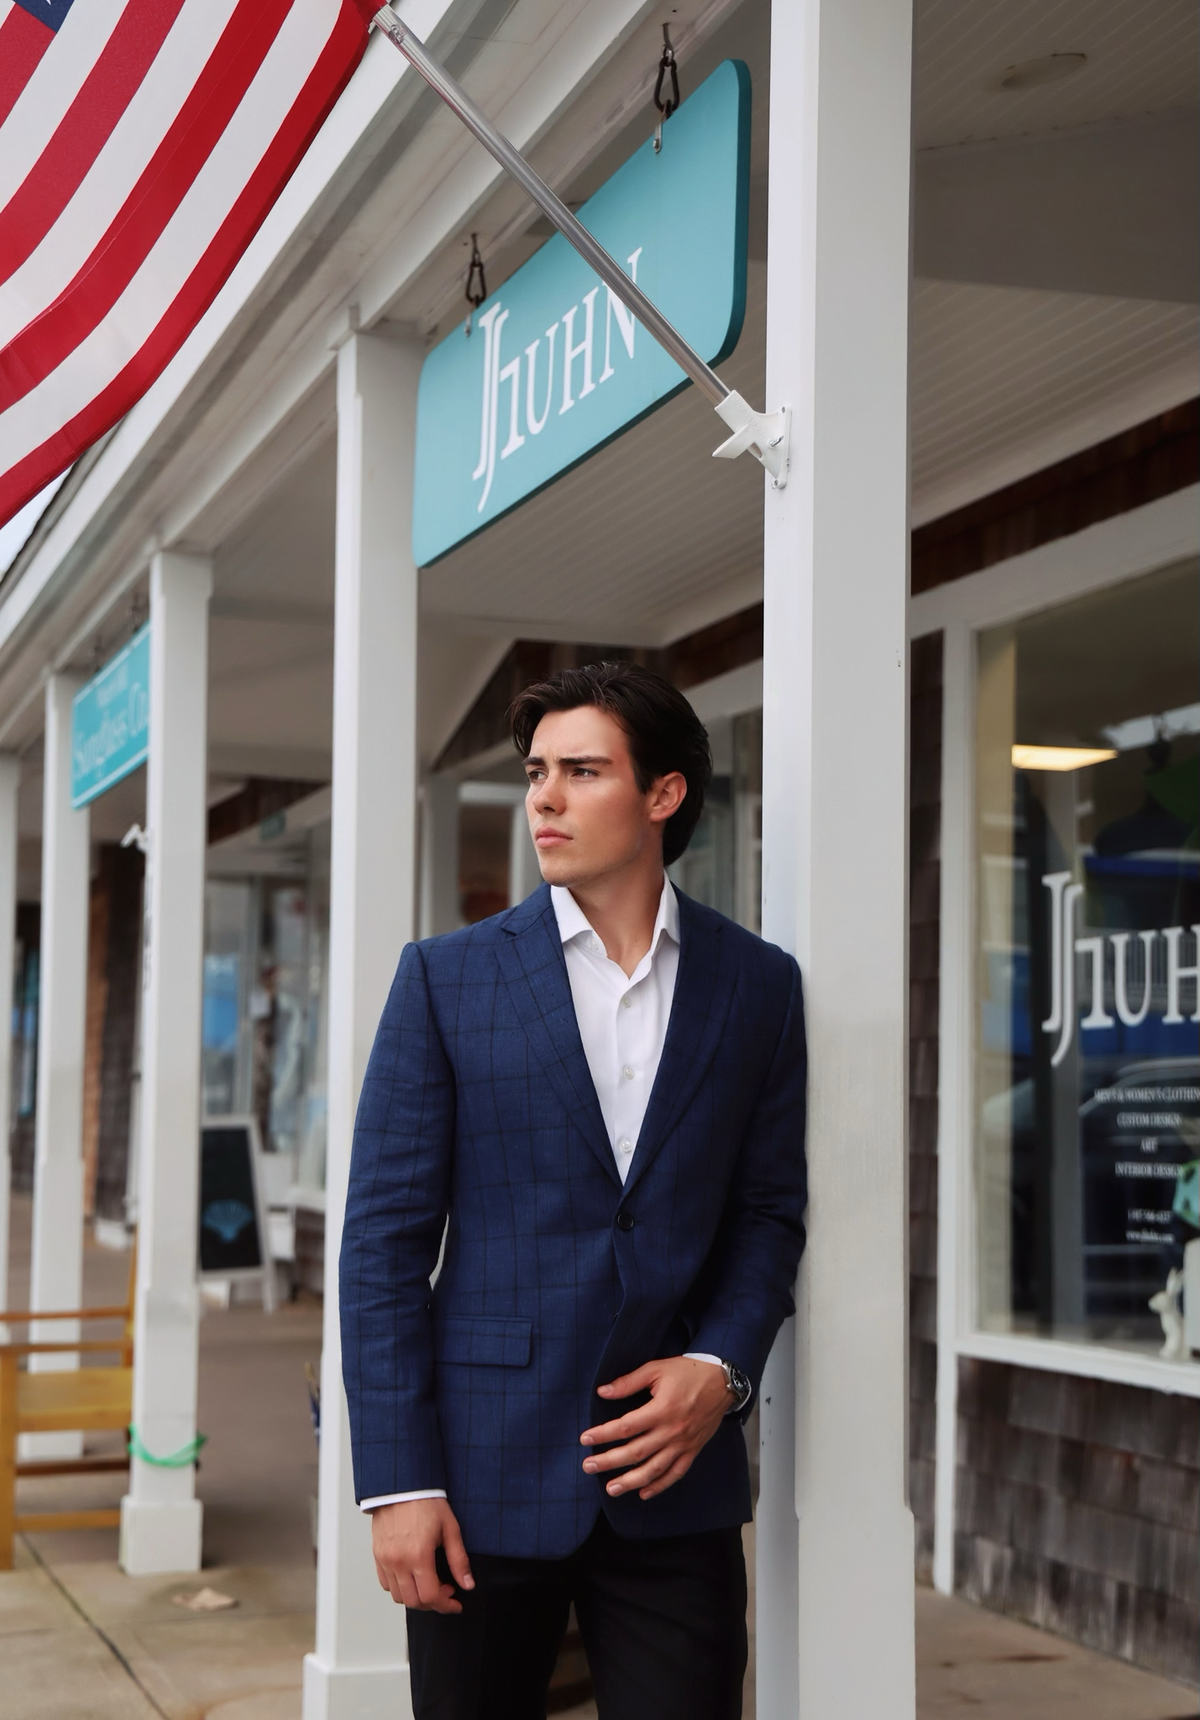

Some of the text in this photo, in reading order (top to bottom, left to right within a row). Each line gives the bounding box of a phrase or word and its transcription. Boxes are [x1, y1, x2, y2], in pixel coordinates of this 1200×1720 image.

[1117, 1112, 1181, 1128] CUSTOM DESIGN
[1141, 1137, 1158, 1153] ART
[1115, 1161, 1185, 1180] INTERIOR DESIGN
